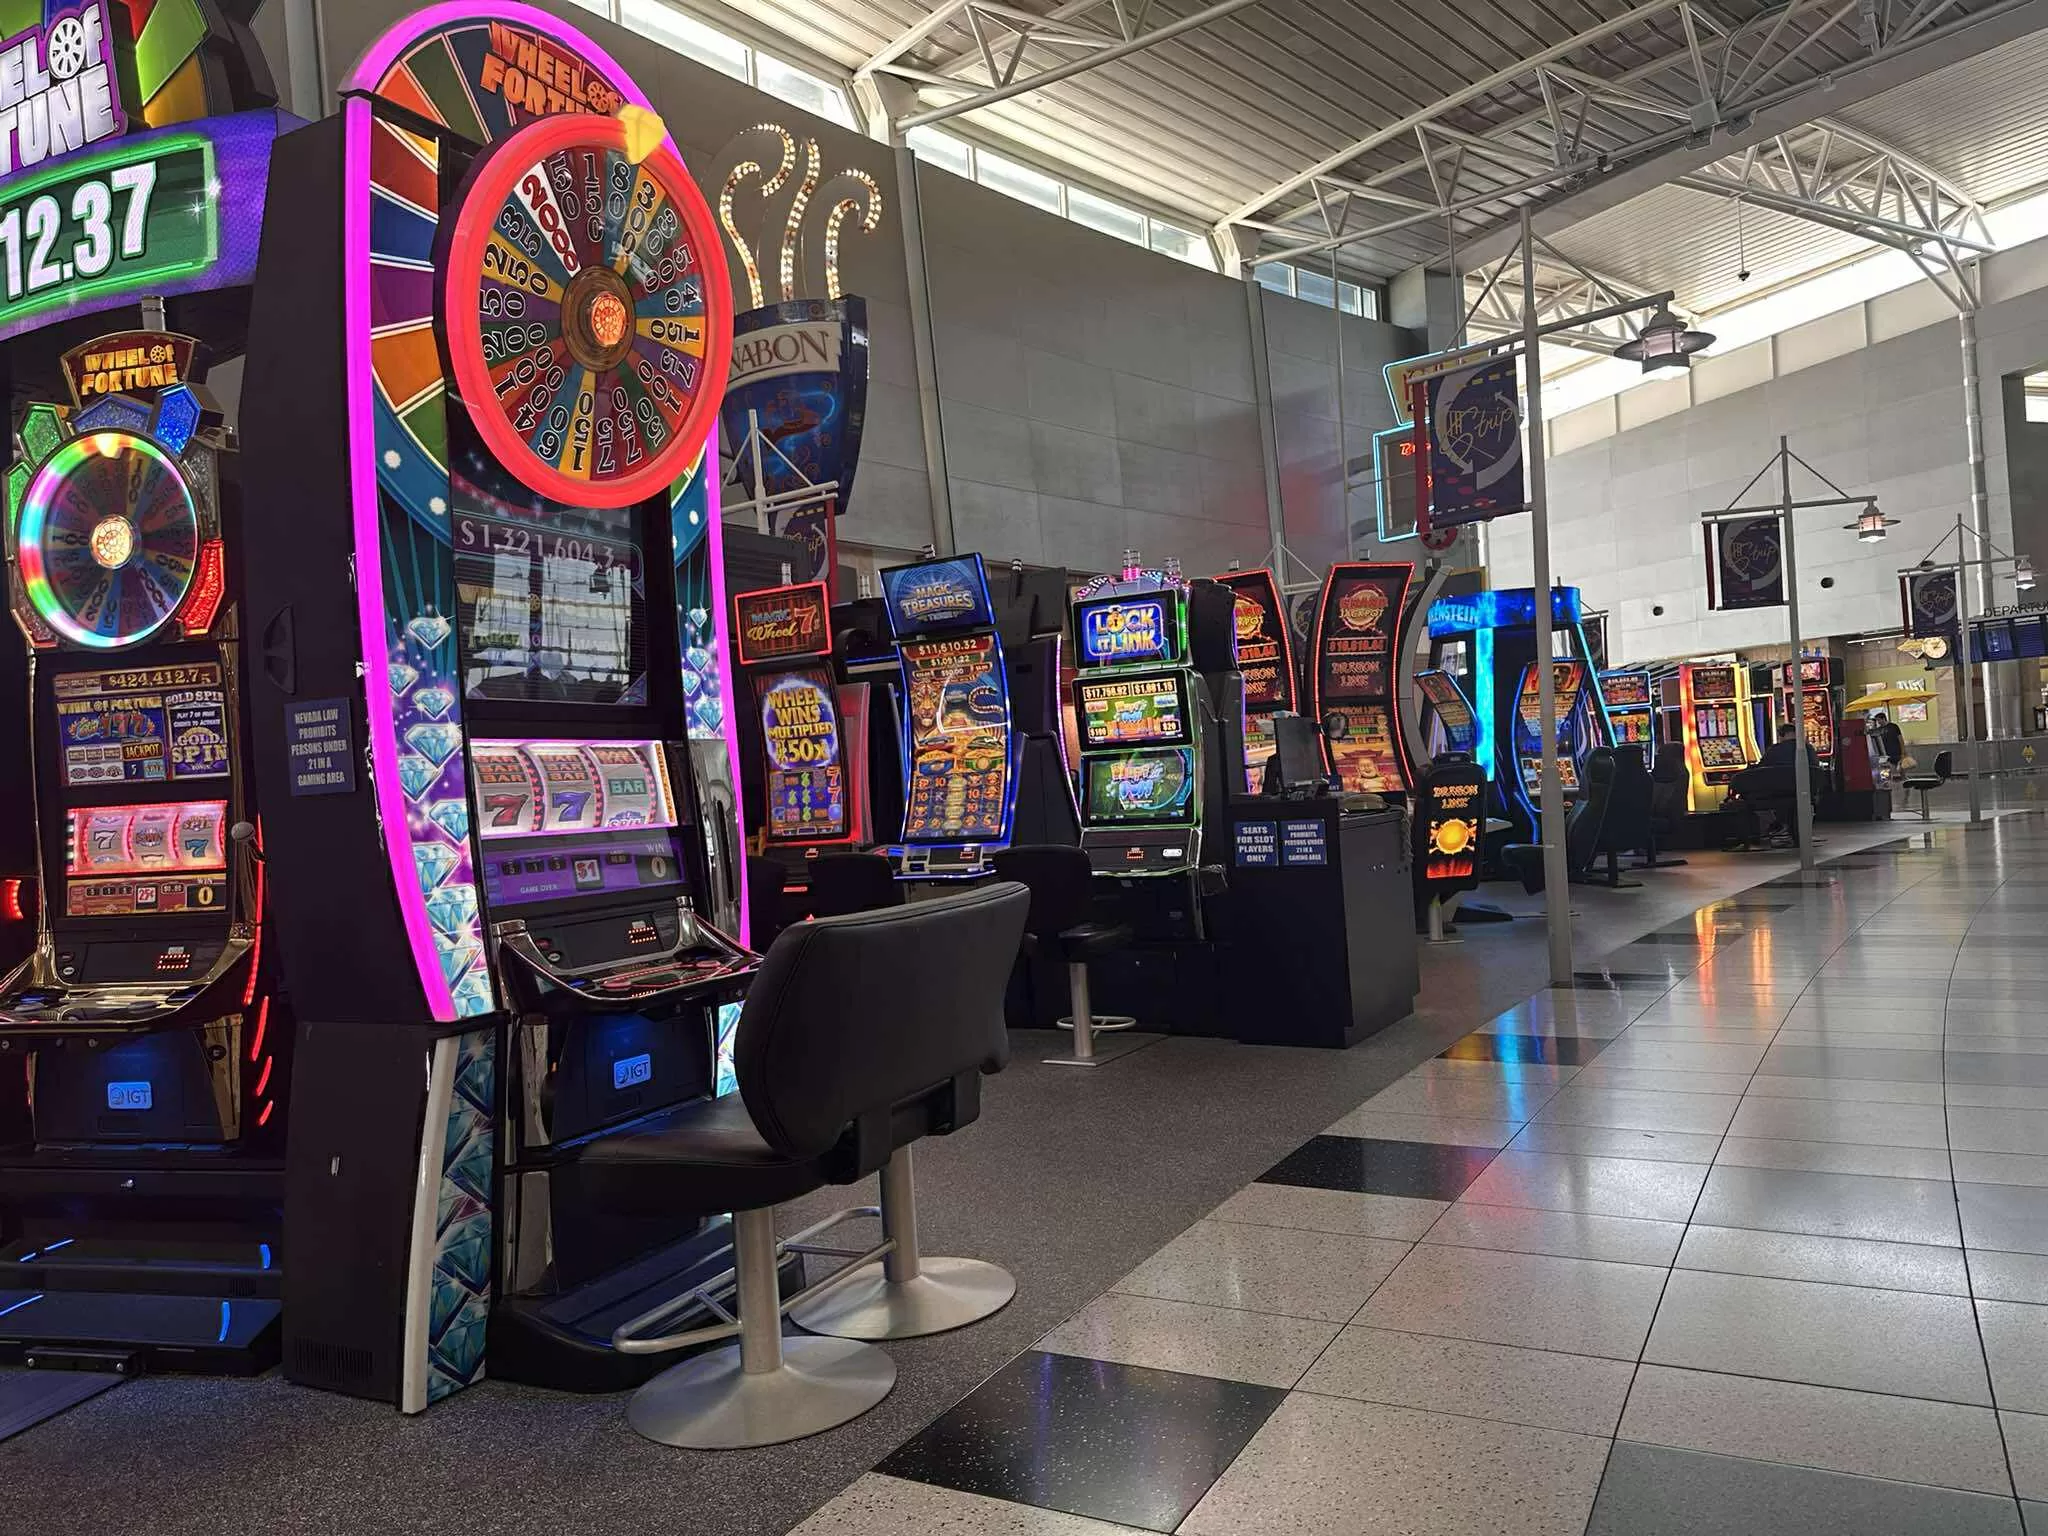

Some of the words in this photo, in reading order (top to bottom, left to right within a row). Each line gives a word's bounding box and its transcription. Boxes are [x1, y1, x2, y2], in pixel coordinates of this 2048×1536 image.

[488, 20, 588, 105] WHEEL
[584, 153, 603, 242] 150
[607, 160, 631, 220] 80
[522, 174, 578, 272] 2000
[621, 180, 658, 255] 300
[500, 204, 543, 258] 35
[483, 242, 549, 296] 250
[643, 243, 694, 293] 500
[480, 288, 525, 318] 50
[480, 322, 547, 361] 200
[650, 318, 700, 344] 150
[85, 347, 150, 372] WHEEL
[660, 348, 696, 389] 75
[82, 363, 178, 396] FORTUNE
[493, 345, 555, 401] 100
[637, 359, 683, 415] 100
[513, 365, 565, 432] 400
[572, 391, 595, 471] 150
[611, 386, 642, 465] 750
[596, 417, 615, 473] 75
[915, 584, 952, 598] MAGIC
[903, 593, 973, 616] TREASURES
[1984, 604, 2048, 617] DEPARTU
[1096, 608, 1154, 633] LOCK
[1111, 631, 1156, 652] LINK
[166, 692, 194, 704] GOLD
[195, 691, 224, 701] SPIN
[767, 687, 820, 708] WHEEL
[294, 710, 321, 724] NEVADA
[322, 708, 338, 721] LAW
[775, 705, 820, 726] WINS
[177, 733, 220, 746] GOLD
[768, 722, 833, 740] MULTIPLIED
[126, 743, 160, 759] JACKPOT
[172, 744, 227, 763] SPIN
[291, 741, 323, 756] PERSONS
[323, 740, 347, 753] UNDER
[308, 758, 317, 770] 21
[317, 757, 326, 769] IN
[326, 756, 332, 768] A
[298, 773, 326, 786] GAMING
[326, 771, 345, 784] AREA
[483, 773, 525, 783] BAR
[551, 772, 586, 781] BAR
[610, 780, 645, 793] BAR
[484, 794, 529, 827] 7
[552, 791, 592, 822] 7
[93, 830, 117, 849] 7
[1237, 836, 1253, 844] FOR
[1254, 835, 1275, 843] SLOT
[1242, 826, 1268, 834] SEATS
[184, 839, 209, 858] 7
[646, 840, 665, 853] WIN
[1239, 845, 1273, 853] PLAYERS
[1246, 854, 1267, 863] ONLY
[520, 885, 538, 893] GAME
[630, 1061, 649, 1078] IGT
[123, 1088, 149, 1104] IGT
